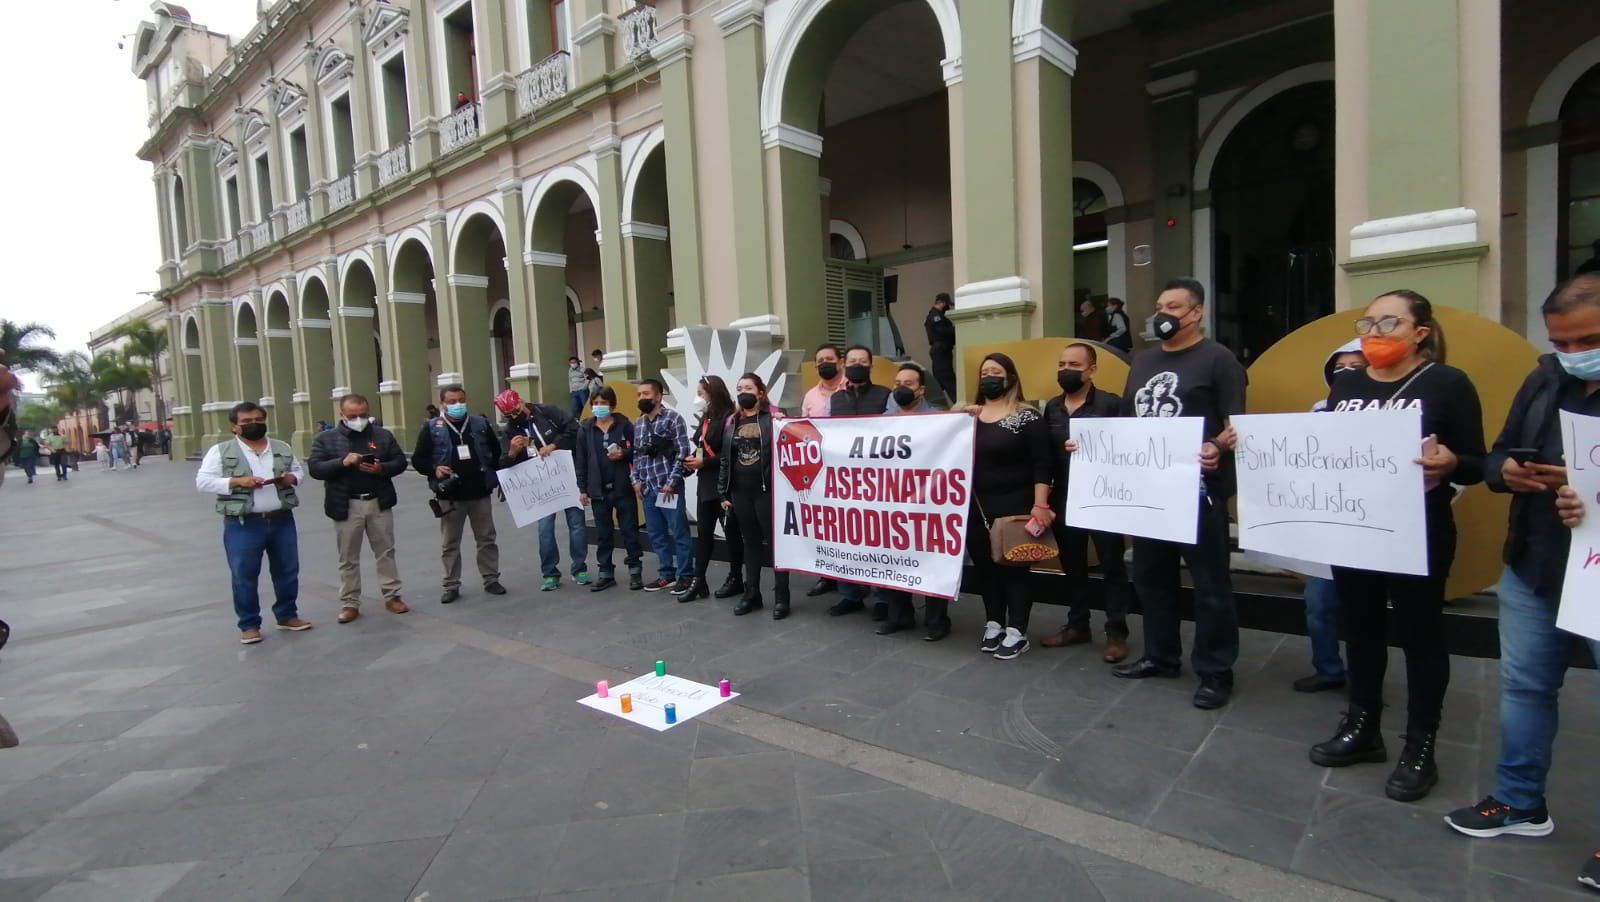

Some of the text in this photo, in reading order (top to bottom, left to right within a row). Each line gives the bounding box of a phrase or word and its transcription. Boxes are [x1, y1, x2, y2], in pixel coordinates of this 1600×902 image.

[779, 440, 821, 468] ALTO
[849, 434, 912, 460] A LOS
[1236, 434, 1398, 475] #SinMasPeriodistas
[824, 466, 966, 506] ASESINATOS
[1093, 474, 1133, 502] Olvido
[1266, 480, 1367, 521] EnSusListas
[783, 501, 963, 557] A PERIODISTAS
[815, 545, 920, 569] #NiSilencioNiOlvido
[814, 559, 922, 587] #PeriodismoEnRiesgo
